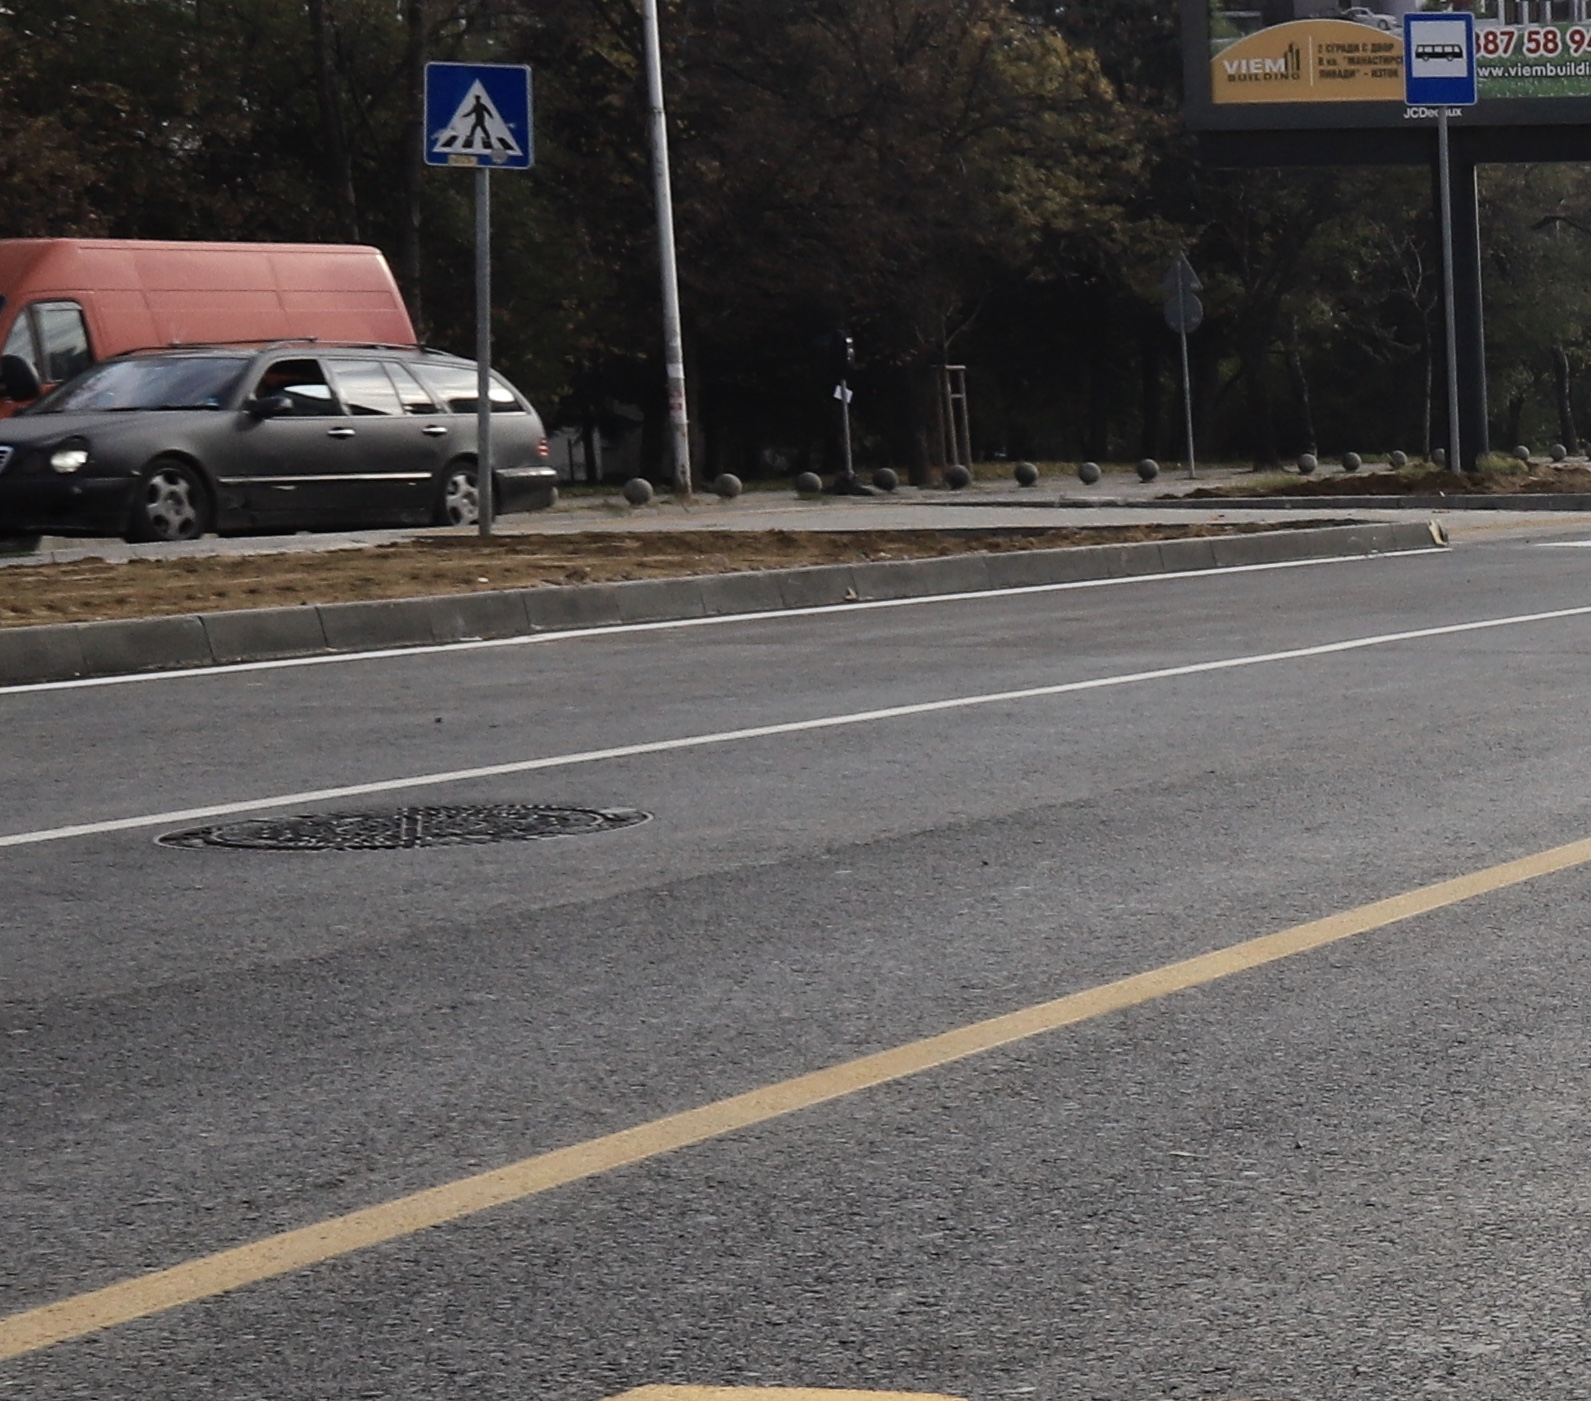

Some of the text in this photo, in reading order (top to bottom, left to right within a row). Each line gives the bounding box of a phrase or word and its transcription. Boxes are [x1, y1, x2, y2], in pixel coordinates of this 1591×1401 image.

[1526, 29, 1560, 54] 58
[1223, 58, 1286, 74] VIEM
[1228, 73, 1300, 82] BUILDING
[1403, 107, 1462, 118] JCDecux
